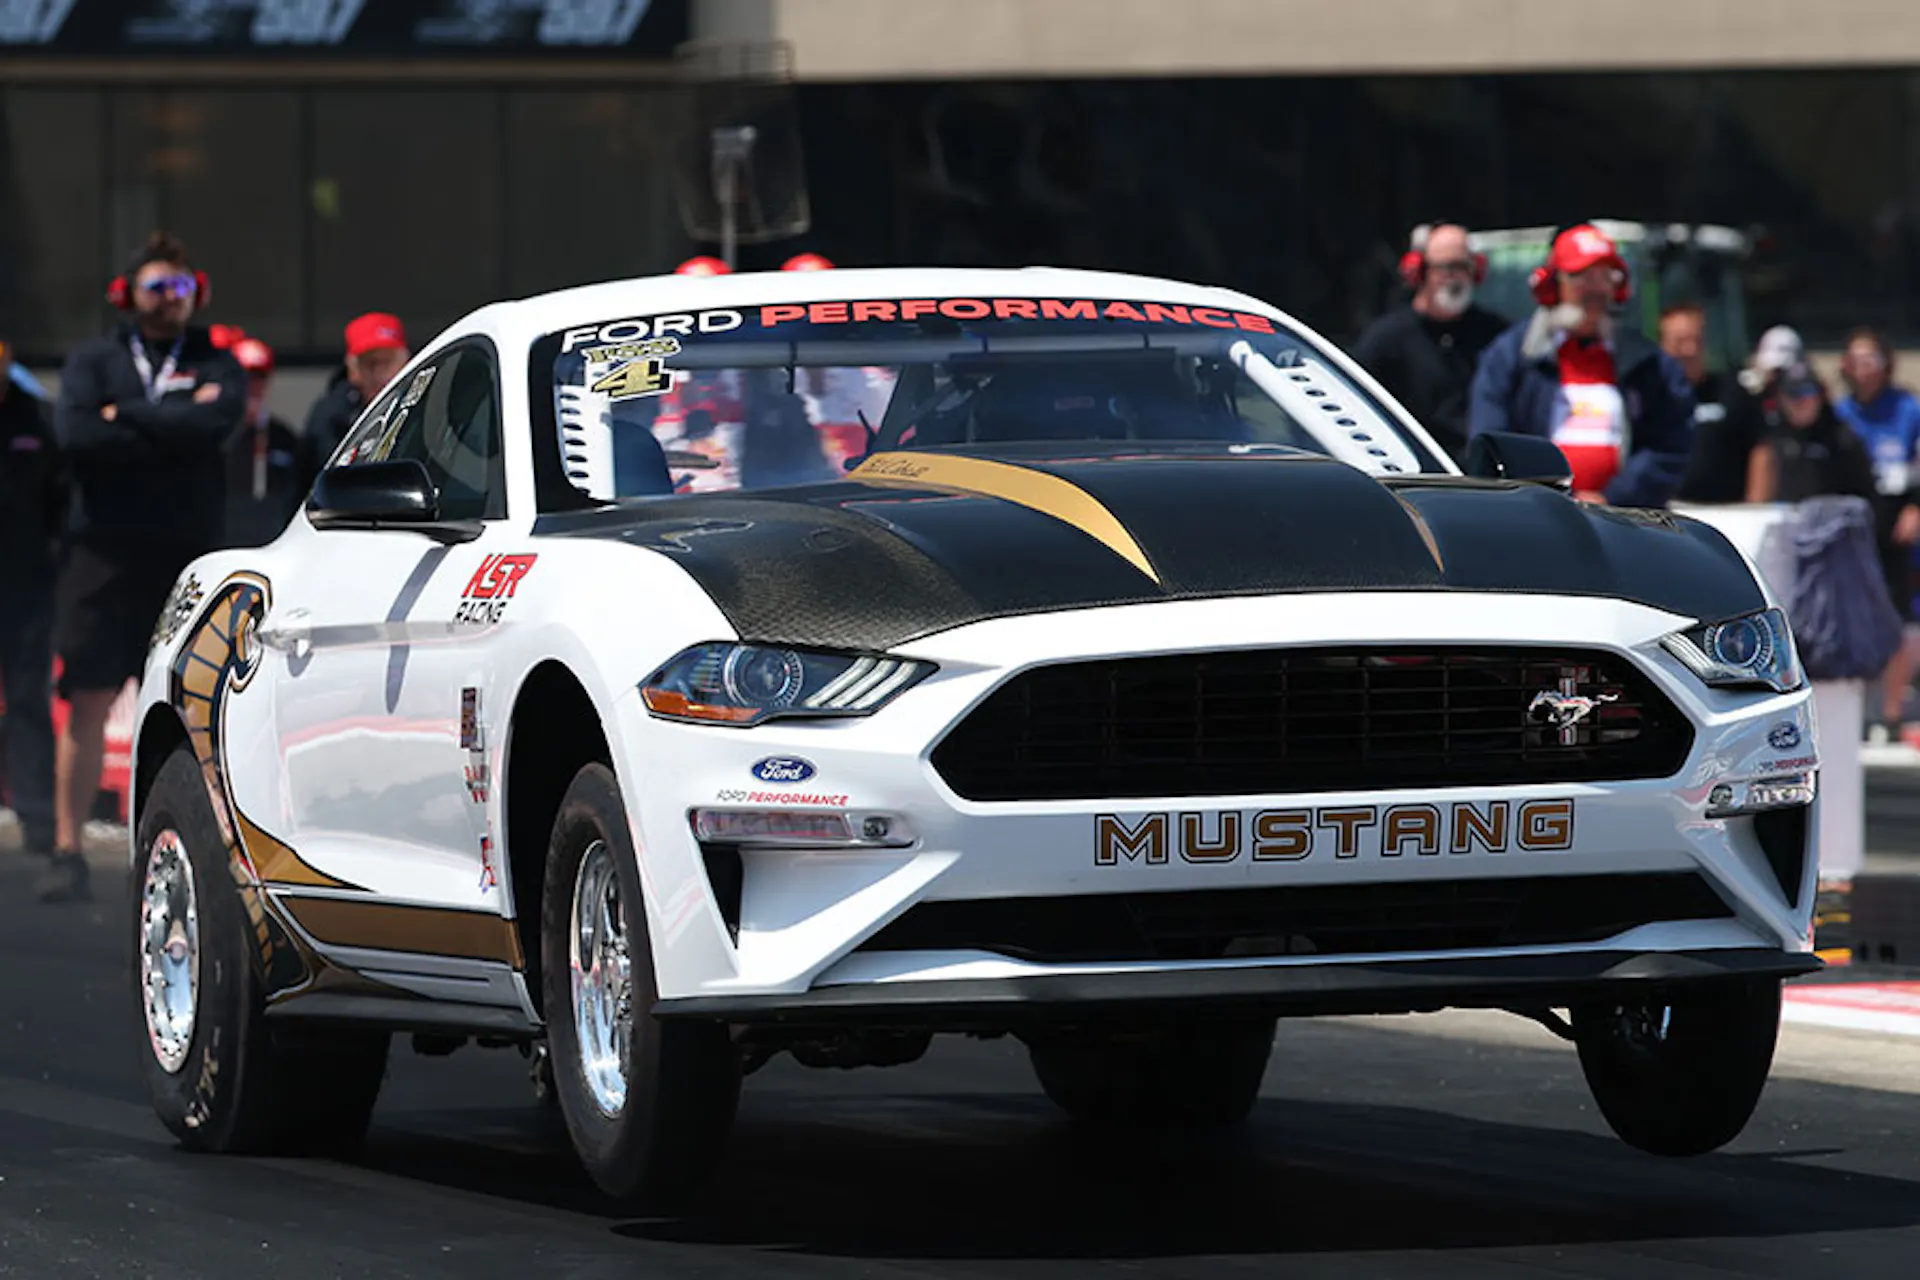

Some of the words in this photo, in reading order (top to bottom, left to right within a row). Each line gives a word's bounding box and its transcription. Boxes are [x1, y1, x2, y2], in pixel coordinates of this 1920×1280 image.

[562, 310, 743, 353] FORD
[760, 299, 1276, 335] PERFORMANCE
[453, 601, 507, 624] RACING
[760, 759, 804, 780] Ford
[747, 791, 849, 806] PERFORMANCE
[1094, 798, 1575, 866] MUSTANG
